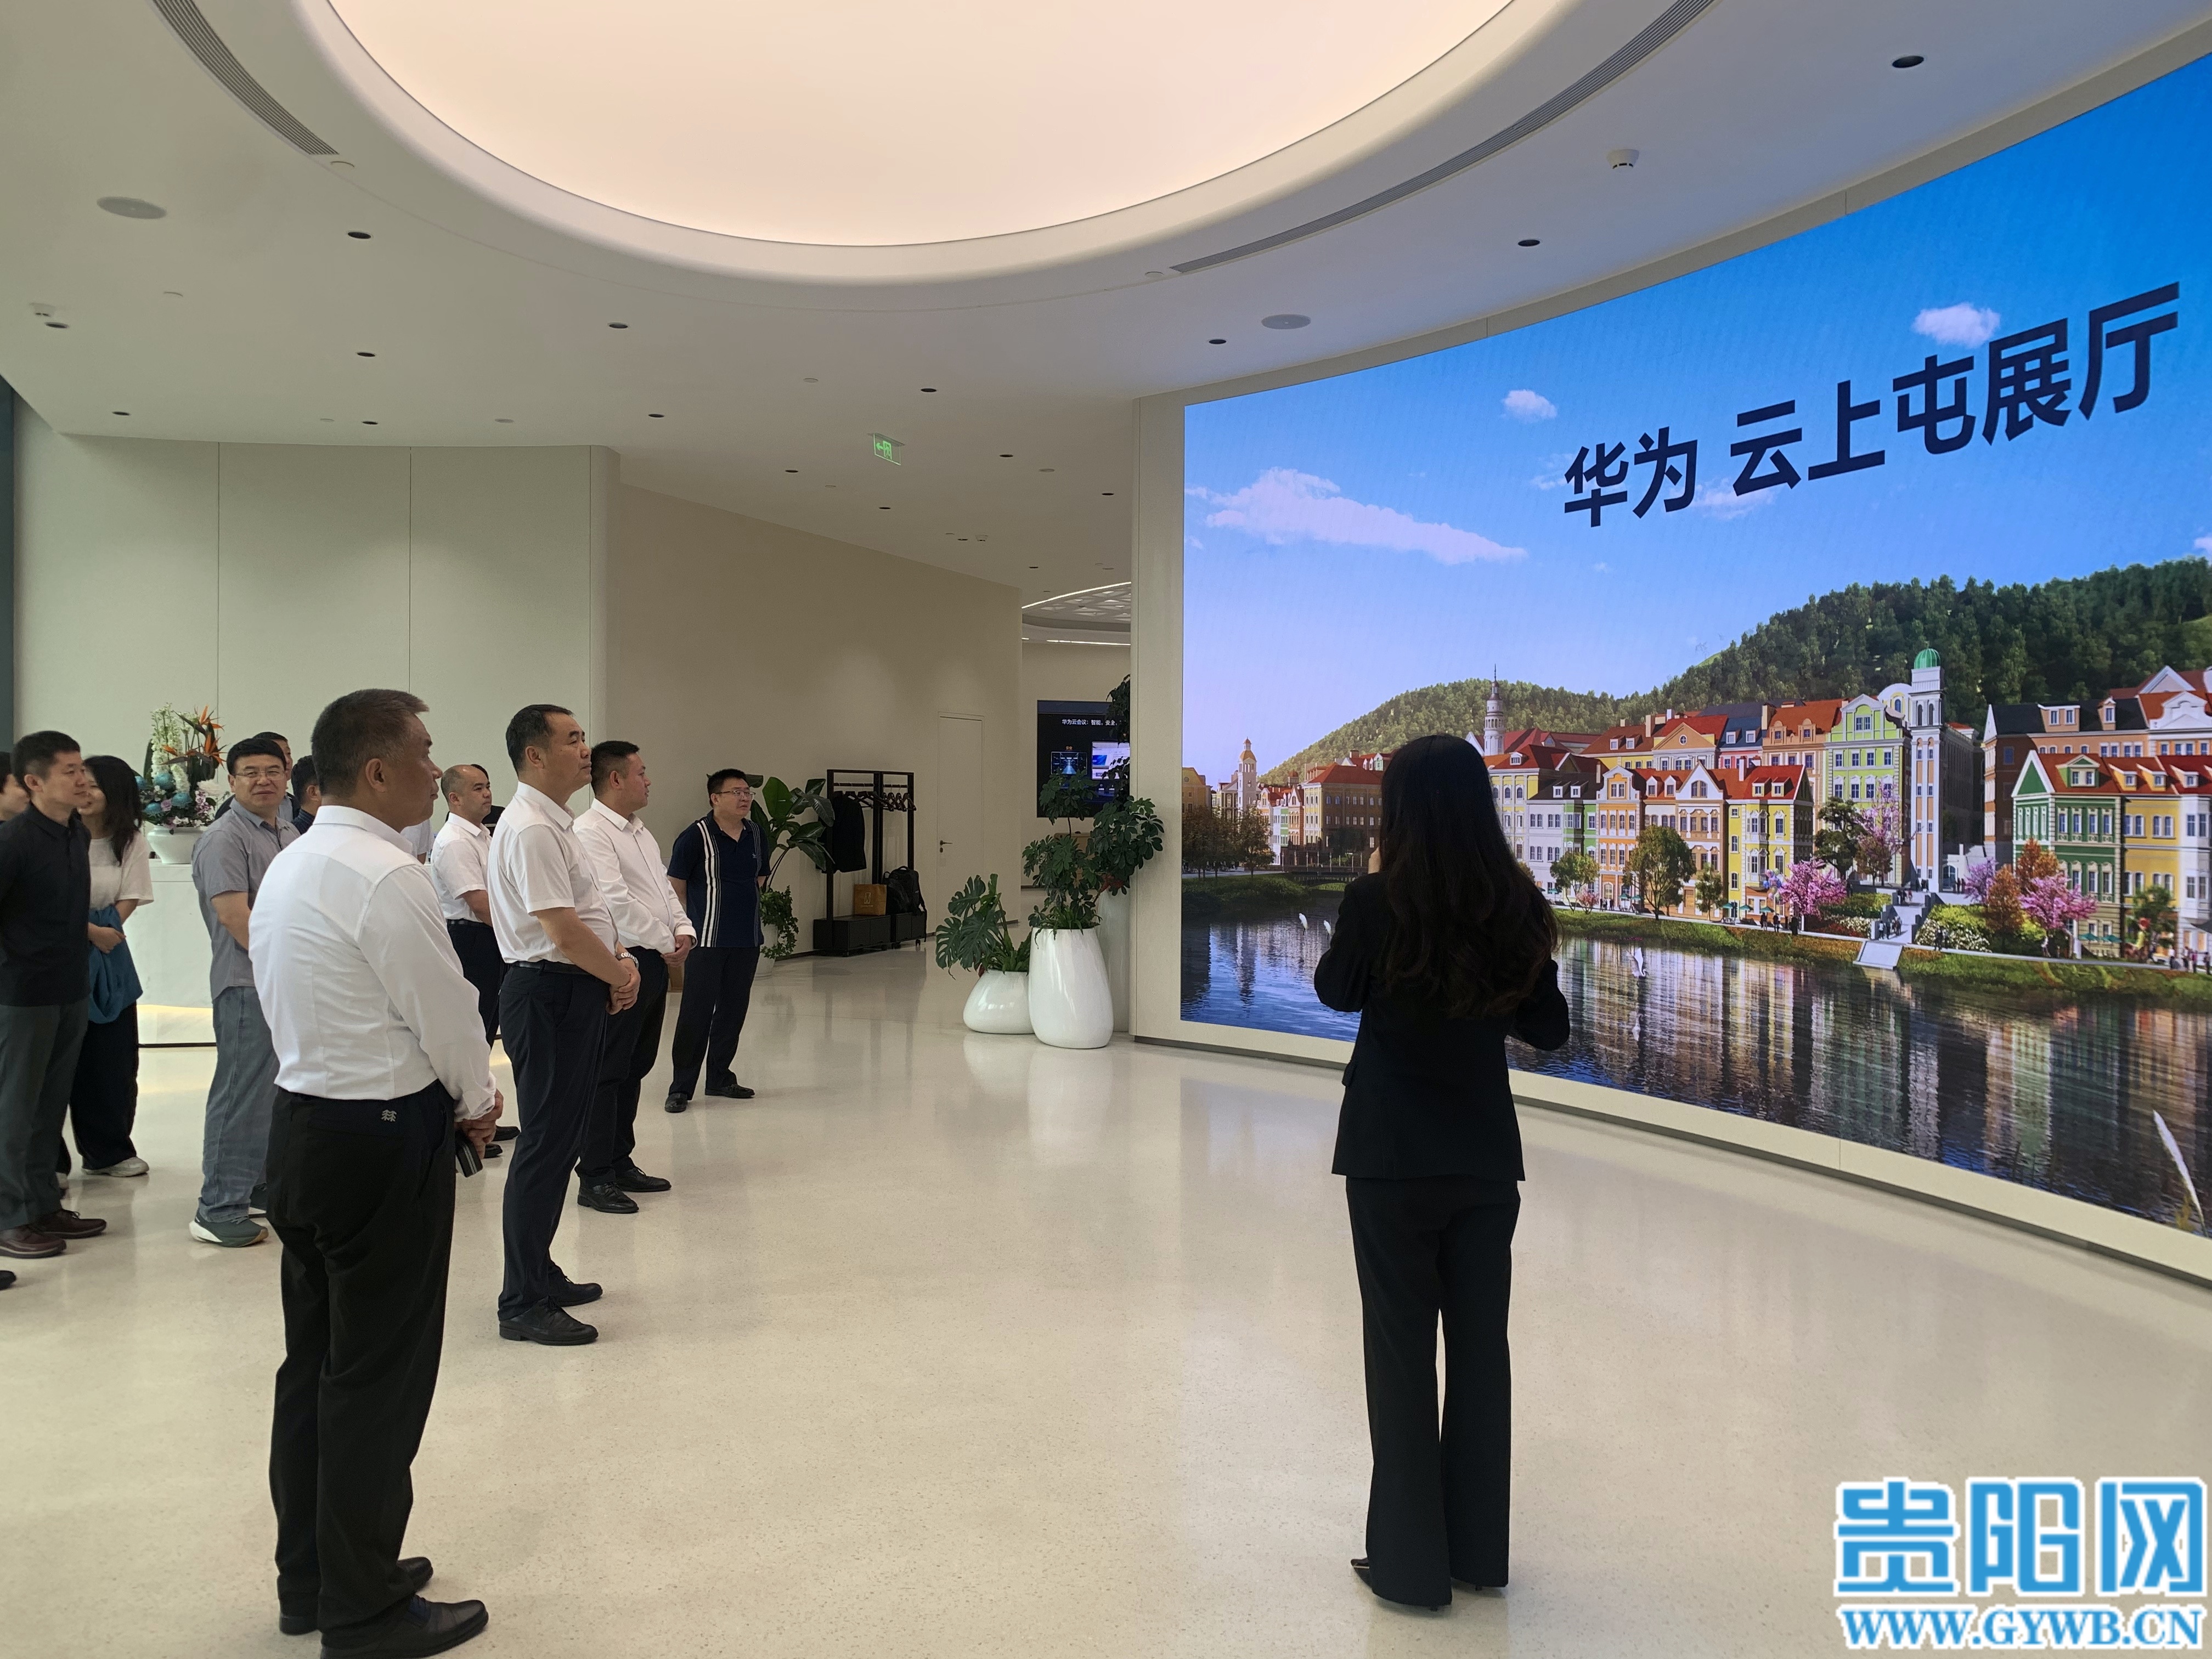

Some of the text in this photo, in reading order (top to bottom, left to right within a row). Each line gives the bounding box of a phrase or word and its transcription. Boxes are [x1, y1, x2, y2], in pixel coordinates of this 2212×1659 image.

[1564, 281, 2179, 527] 华为 云上屯展厅
